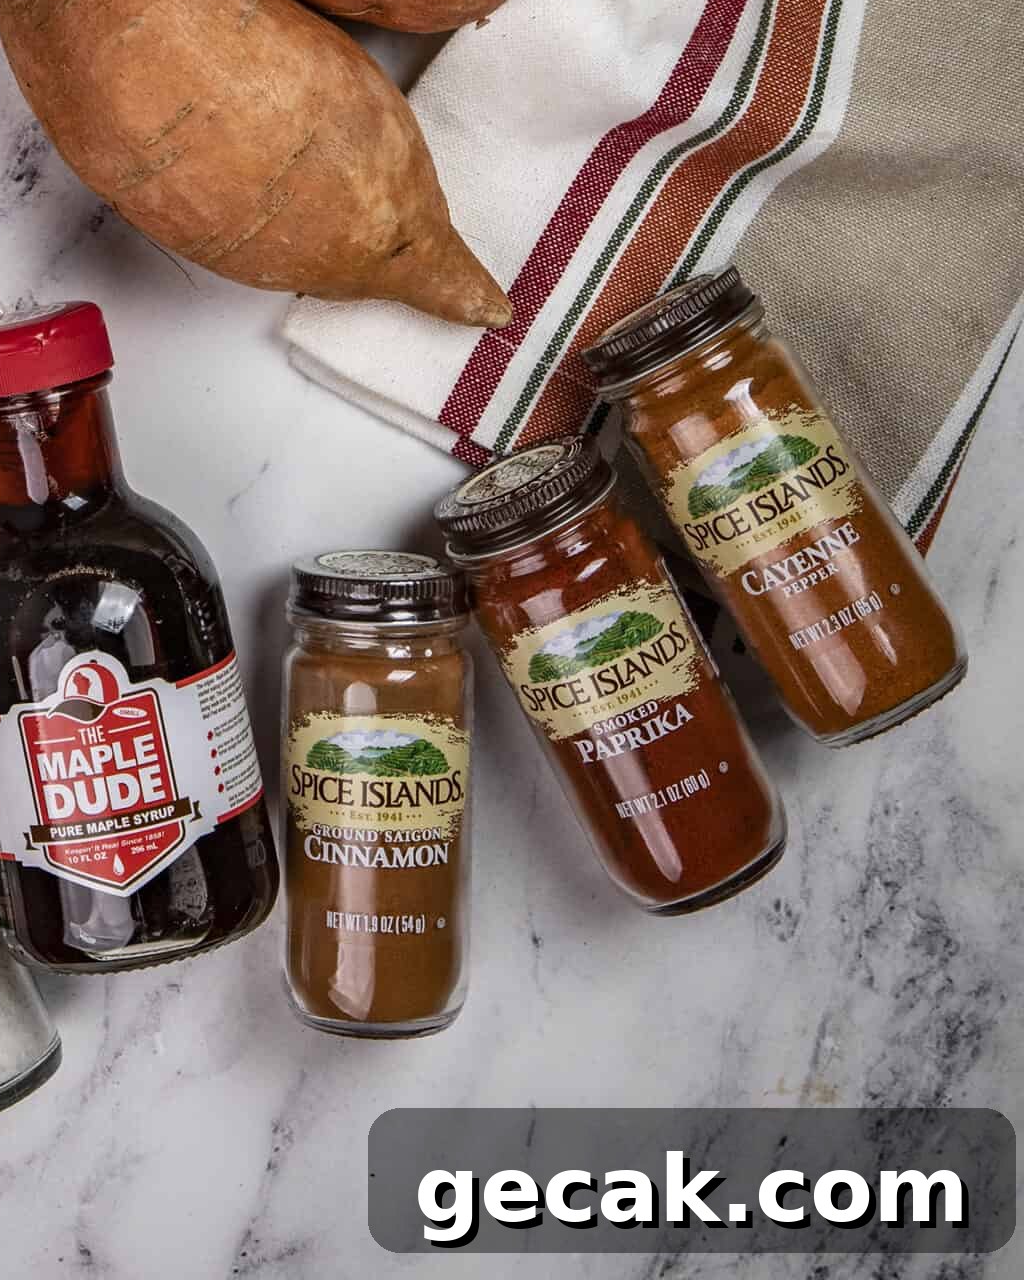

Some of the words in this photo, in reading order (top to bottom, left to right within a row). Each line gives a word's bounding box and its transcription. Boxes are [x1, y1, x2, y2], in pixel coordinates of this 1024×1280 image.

[684, 508, 752, 552] SPICE
[745, 445, 848, 528] ISLANDS
[775, 511, 802, 532] 1941
[741, 521, 861, 596] CAYENNE
[781, 561, 839, 599] PEPPER
[788, 630, 809, 651] NET
[806, 622, 825, 641] WT
[822, 614, 843, 635] 2.3
[837, 606, 856, 627] OZ
[520, 683, 592, 712] SPICE
[590, 621, 686, 699] ISLANDS
[616, 687, 642, 706] 1941
[78, 724, 107, 746] THE
[573, 703, 694, 764] PAPRIKA
[593, 699, 659, 736] SMOKED
[34, 733, 161, 782] MAPLE
[42, 765, 166, 820] DUDE
[291, 764, 354, 807] SPICE
[361, 770, 461, 808] ISLANDS
[615, 800, 636, 819] NET
[633, 795, 653, 814] WT
[650, 789, 668, 809] 2.1
[666, 783, 684, 802] OZ
[50, 825, 84, 839] PURE
[86, 816, 131, 834] MAPLE
[133, 805, 176, 825] SYRUP
[312, 824, 377, 842] GROUND
[384, 828, 442, 843] SAIGON
[377, 812, 402, 822] 1941
[68, 856, 79, 865] 10
[81, 853, 92, 863] FL
[94, 851, 108, 861] OZ
[130, 846, 146, 855] 296
[146, 842, 159, 852] mL
[121, 837, 143, 848] Since
[304, 834, 450, 868] CINNAMON
[326, 910, 344, 929] NET
[345, 911, 361, 932] WT
[364, 914, 379, 933] 1.9
[380, 915, 394, 933] OZ
